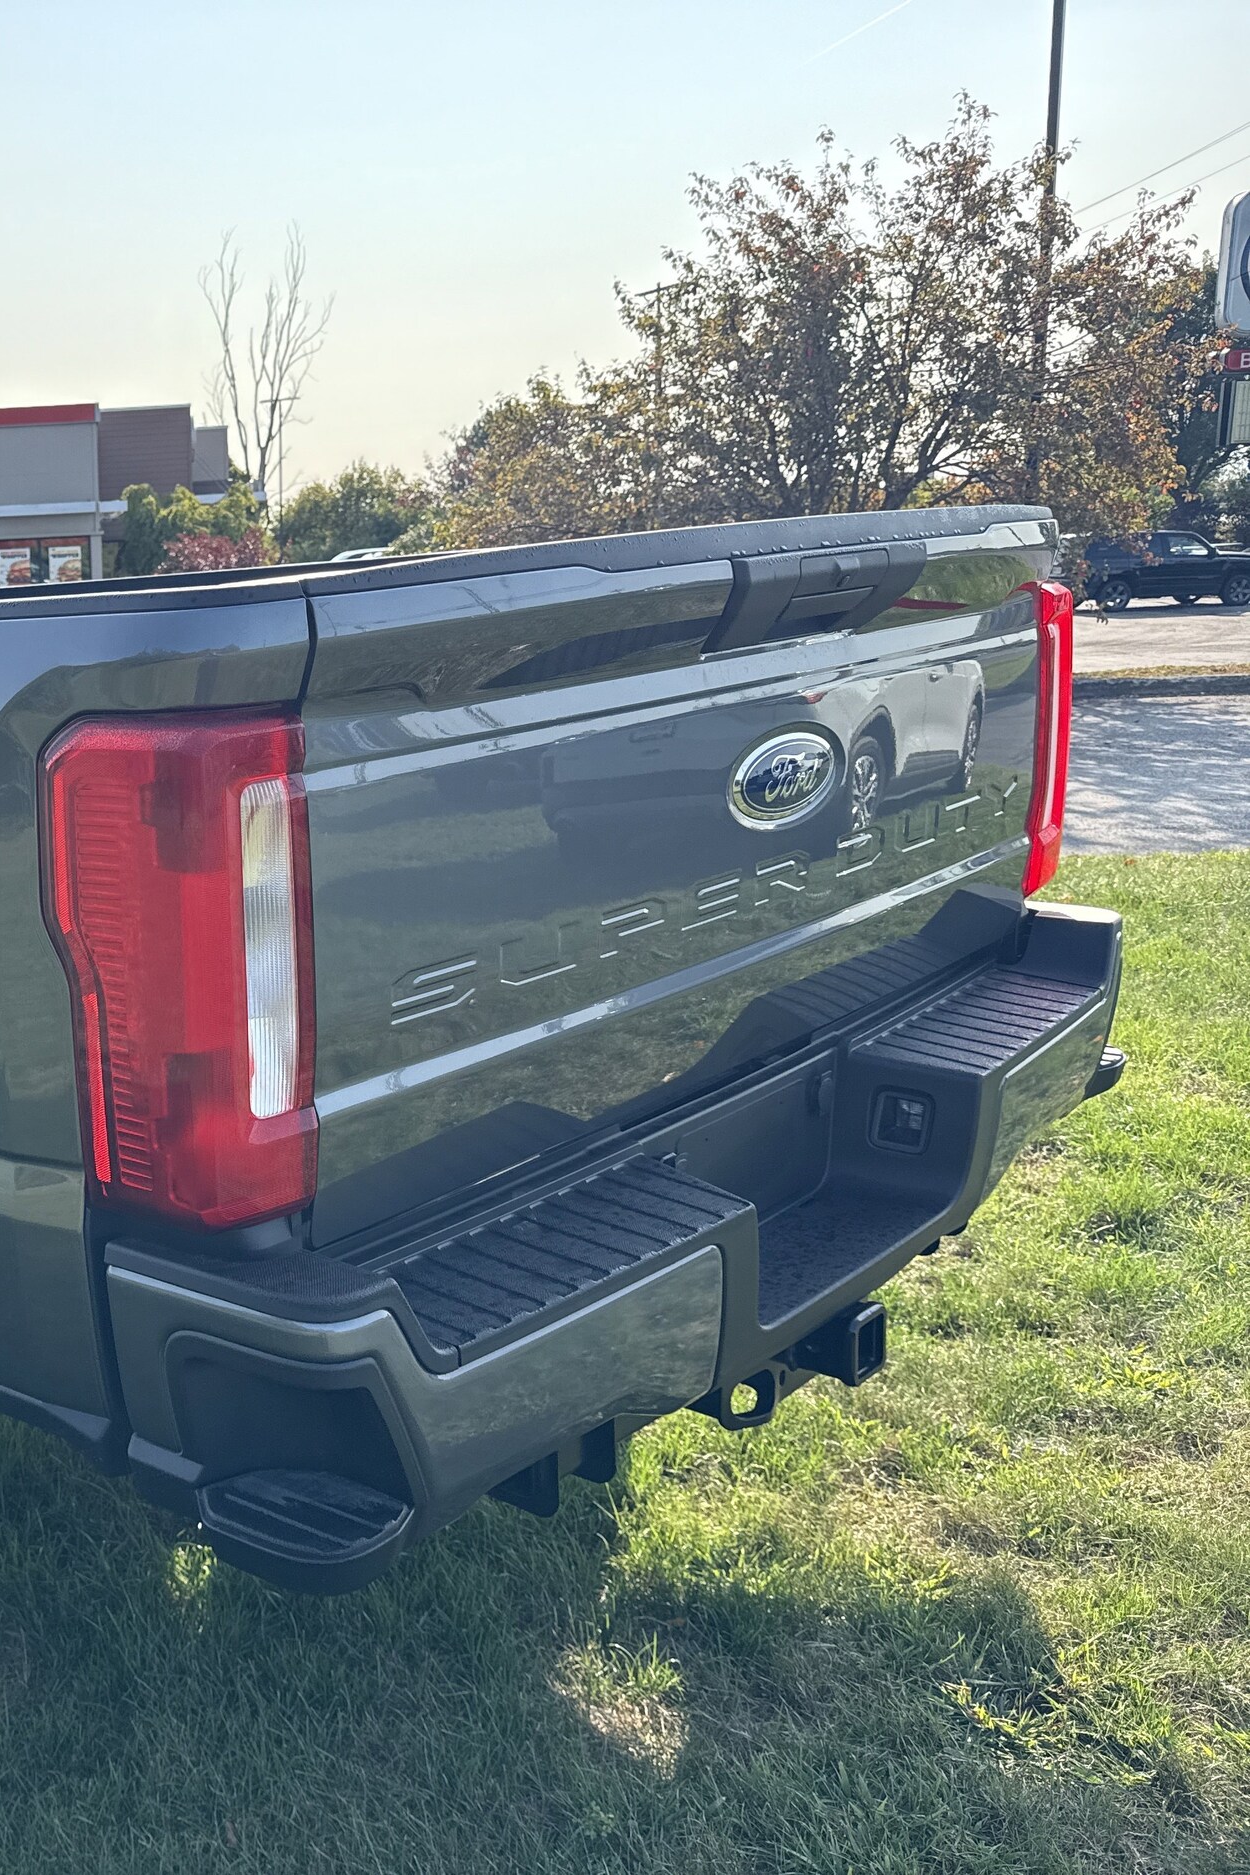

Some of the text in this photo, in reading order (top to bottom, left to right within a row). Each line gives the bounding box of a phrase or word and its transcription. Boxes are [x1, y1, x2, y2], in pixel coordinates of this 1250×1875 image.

[764, 751, 820, 803] Ford
[391, 773, 1019, 1025] SUPER DUTY
